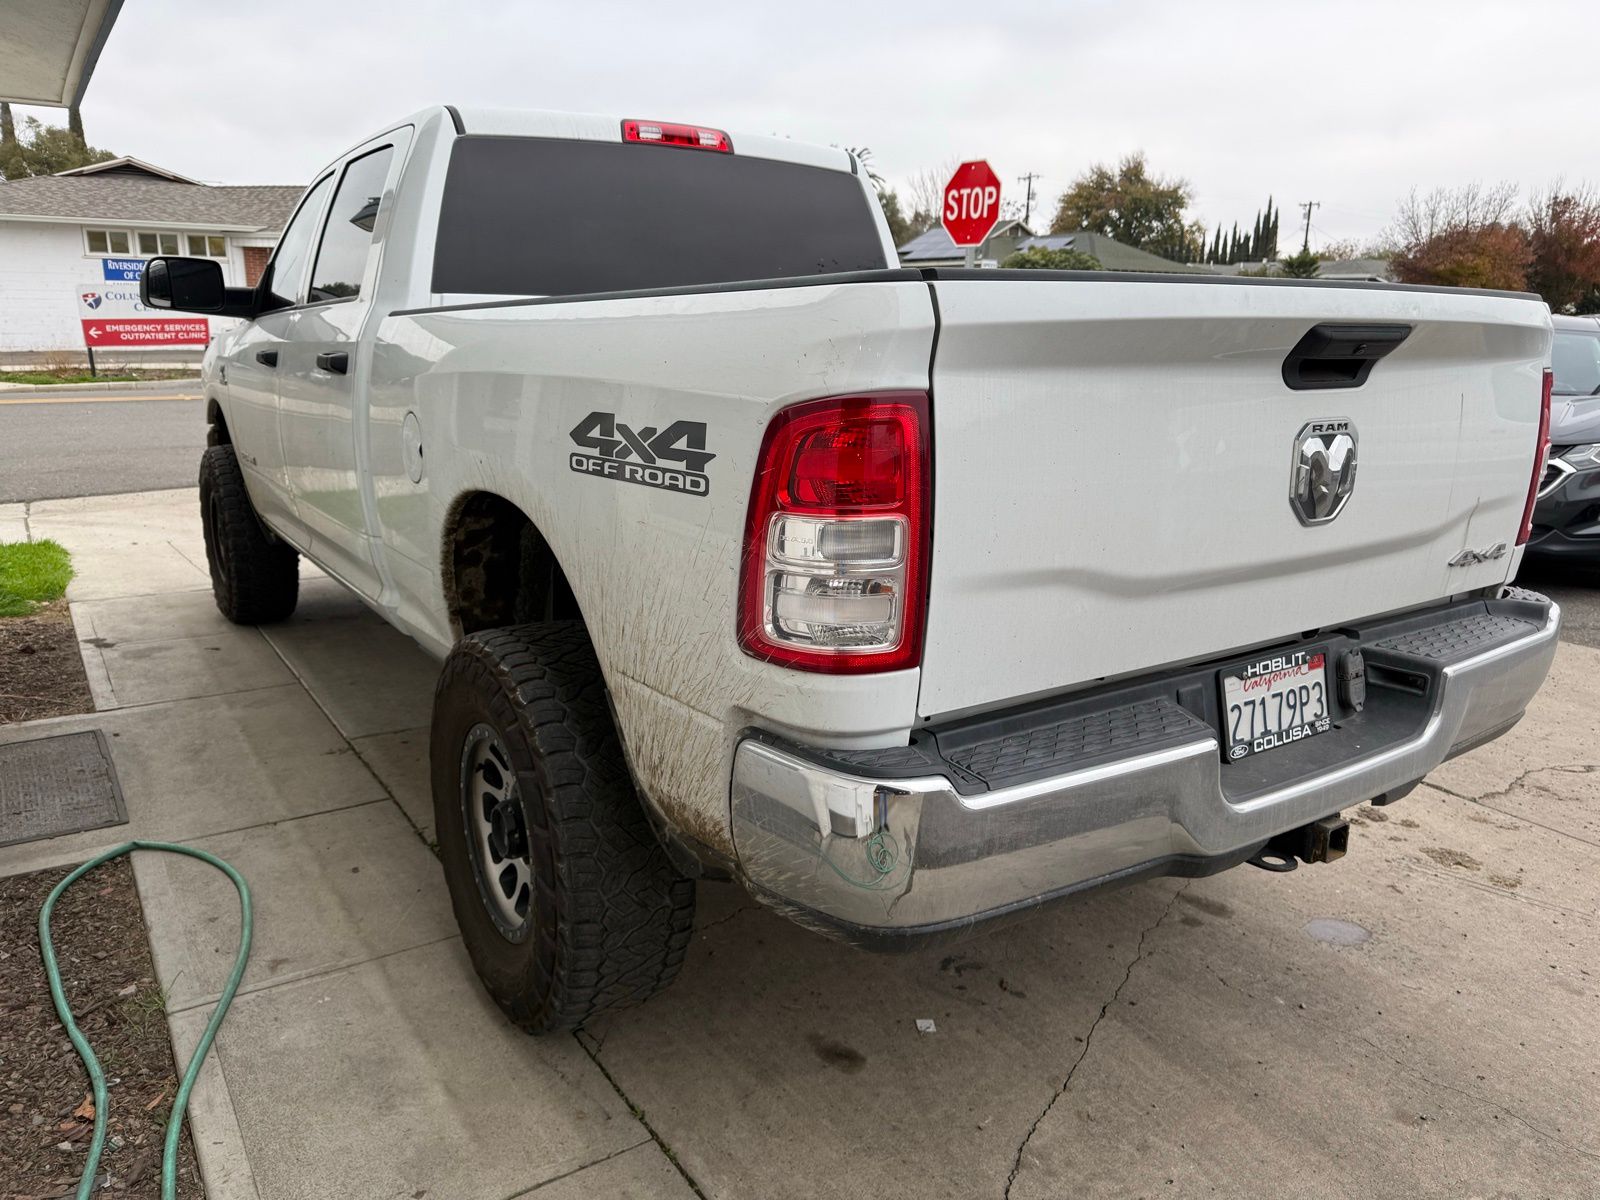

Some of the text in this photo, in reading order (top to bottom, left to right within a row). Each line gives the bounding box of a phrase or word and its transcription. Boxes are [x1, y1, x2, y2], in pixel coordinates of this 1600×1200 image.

[946, 186, 997, 221] STOP
[107, 260, 144, 271] RIVERSIDE
[123, 271, 135, 280] OF
[105, 323, 206, 332] EMERGENCY SERVICES
[120, 332, 177, 340] OUTPATIENT
[1312, 422, 1348, 432] RAM
[571, 455, 706, 493] OFF ROAD
[1247, 652, 1306, 677] HOBLIT
[1243, 665, 1308, 692] California
[1230, 681, 1325, 745] 27179P3
[1253, 725, 1312, 753] COLUSA
